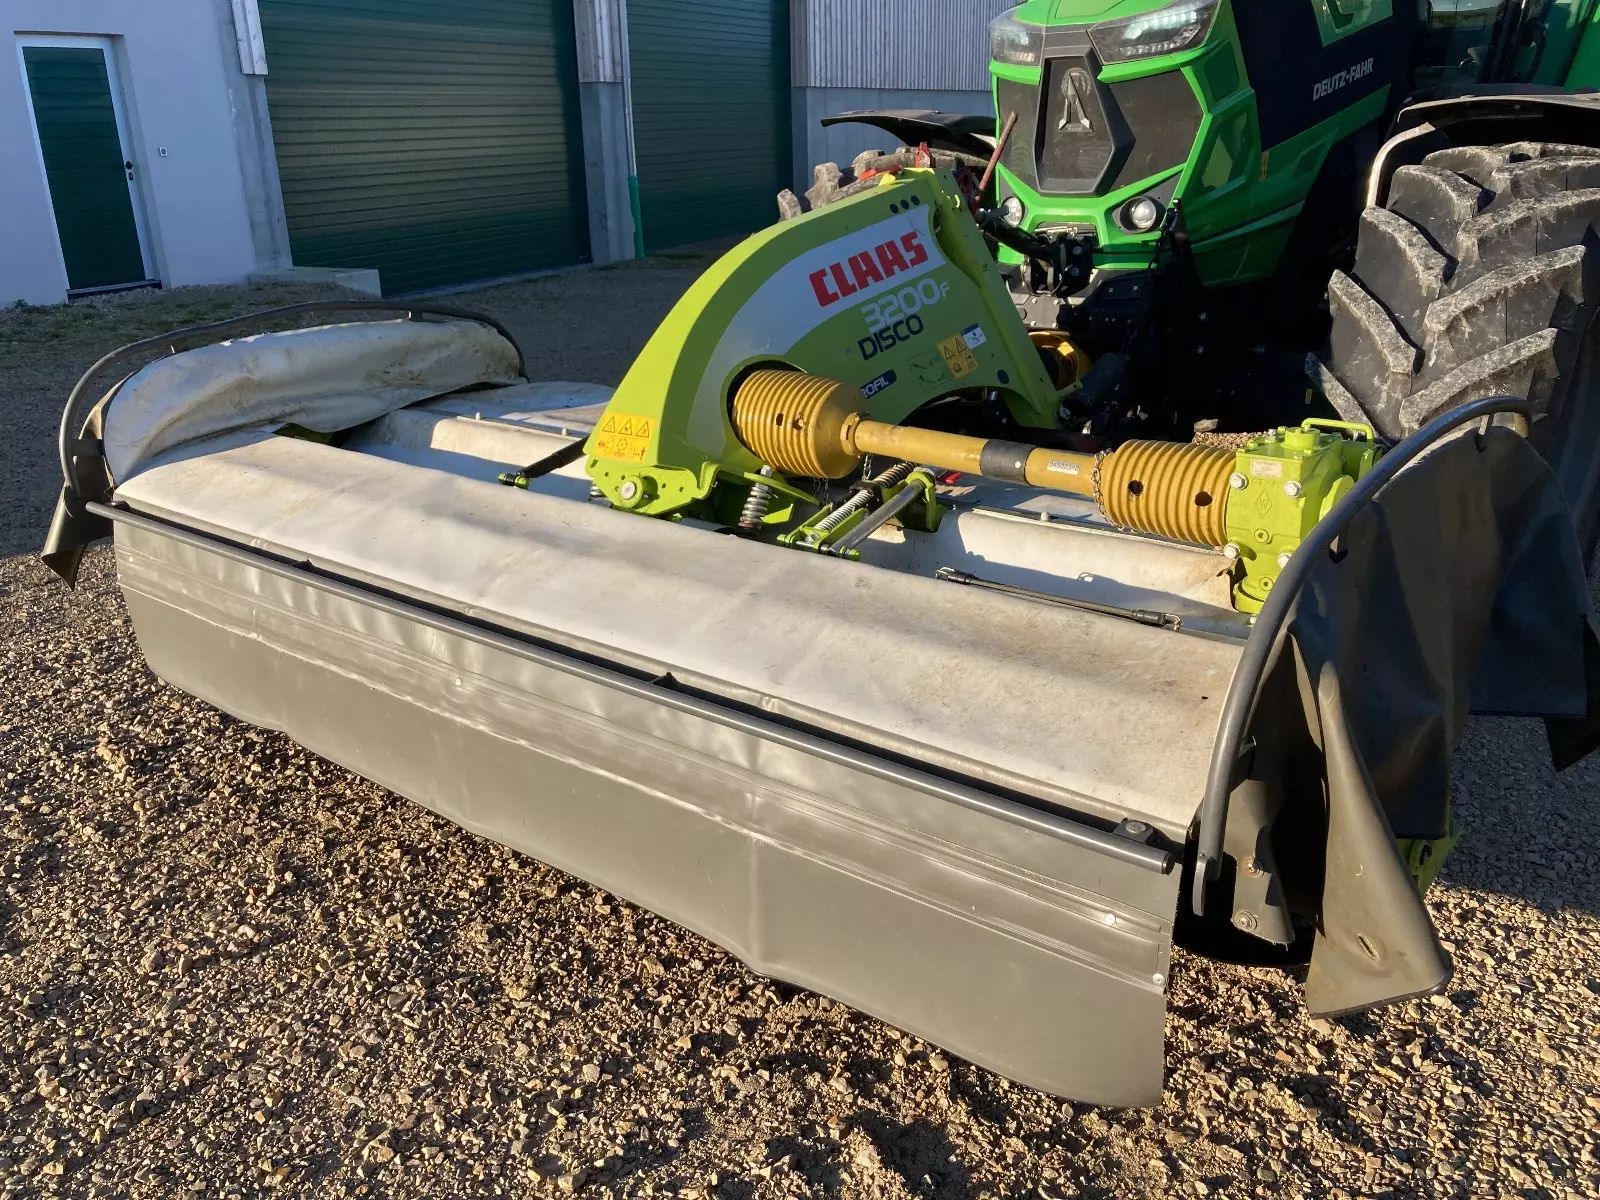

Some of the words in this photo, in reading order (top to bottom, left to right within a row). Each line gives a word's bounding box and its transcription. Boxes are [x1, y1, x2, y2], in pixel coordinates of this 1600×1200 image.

[1313, 58, 1373, 101] DEUTZ-FAHR
[809, 230, 929, 307] CLAAS
[857, 313, 924, 361] DISCO
